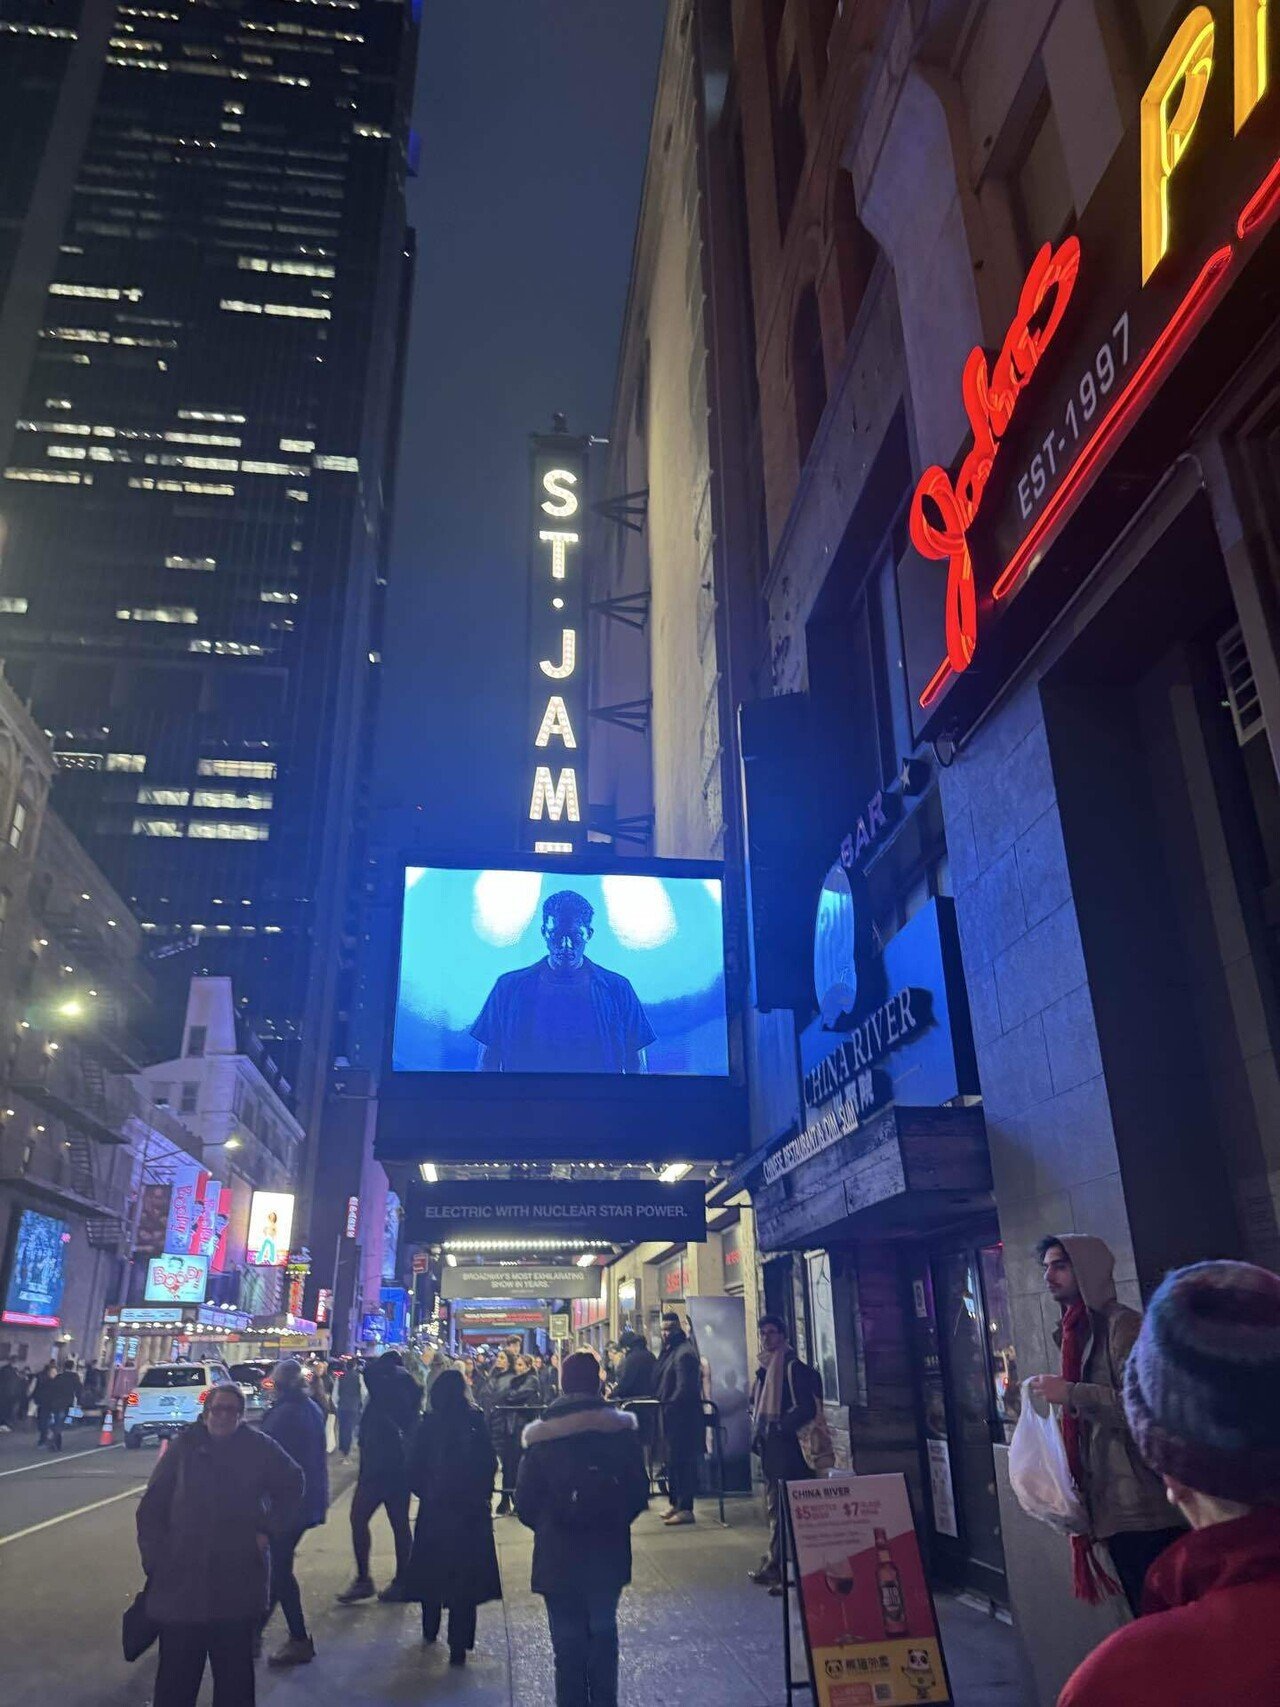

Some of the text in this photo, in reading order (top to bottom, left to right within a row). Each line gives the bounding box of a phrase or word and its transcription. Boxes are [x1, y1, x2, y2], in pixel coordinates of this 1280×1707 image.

[529, 628, 581, 854] JAM
[840, 788, 887, 869] BAR
[803, 1041, 850, 1109] CHINA
[851, 985, 917, 1072] RIVER
[425, 1205, 688, 1219] ELECTRIC WITH NUCLEAR STAR POWER.
[792, 1486, 851, 1499] CHINA RIVER
[795, 1505, 812, 1520] $5
[843, 1502, 859, 1517] $7
